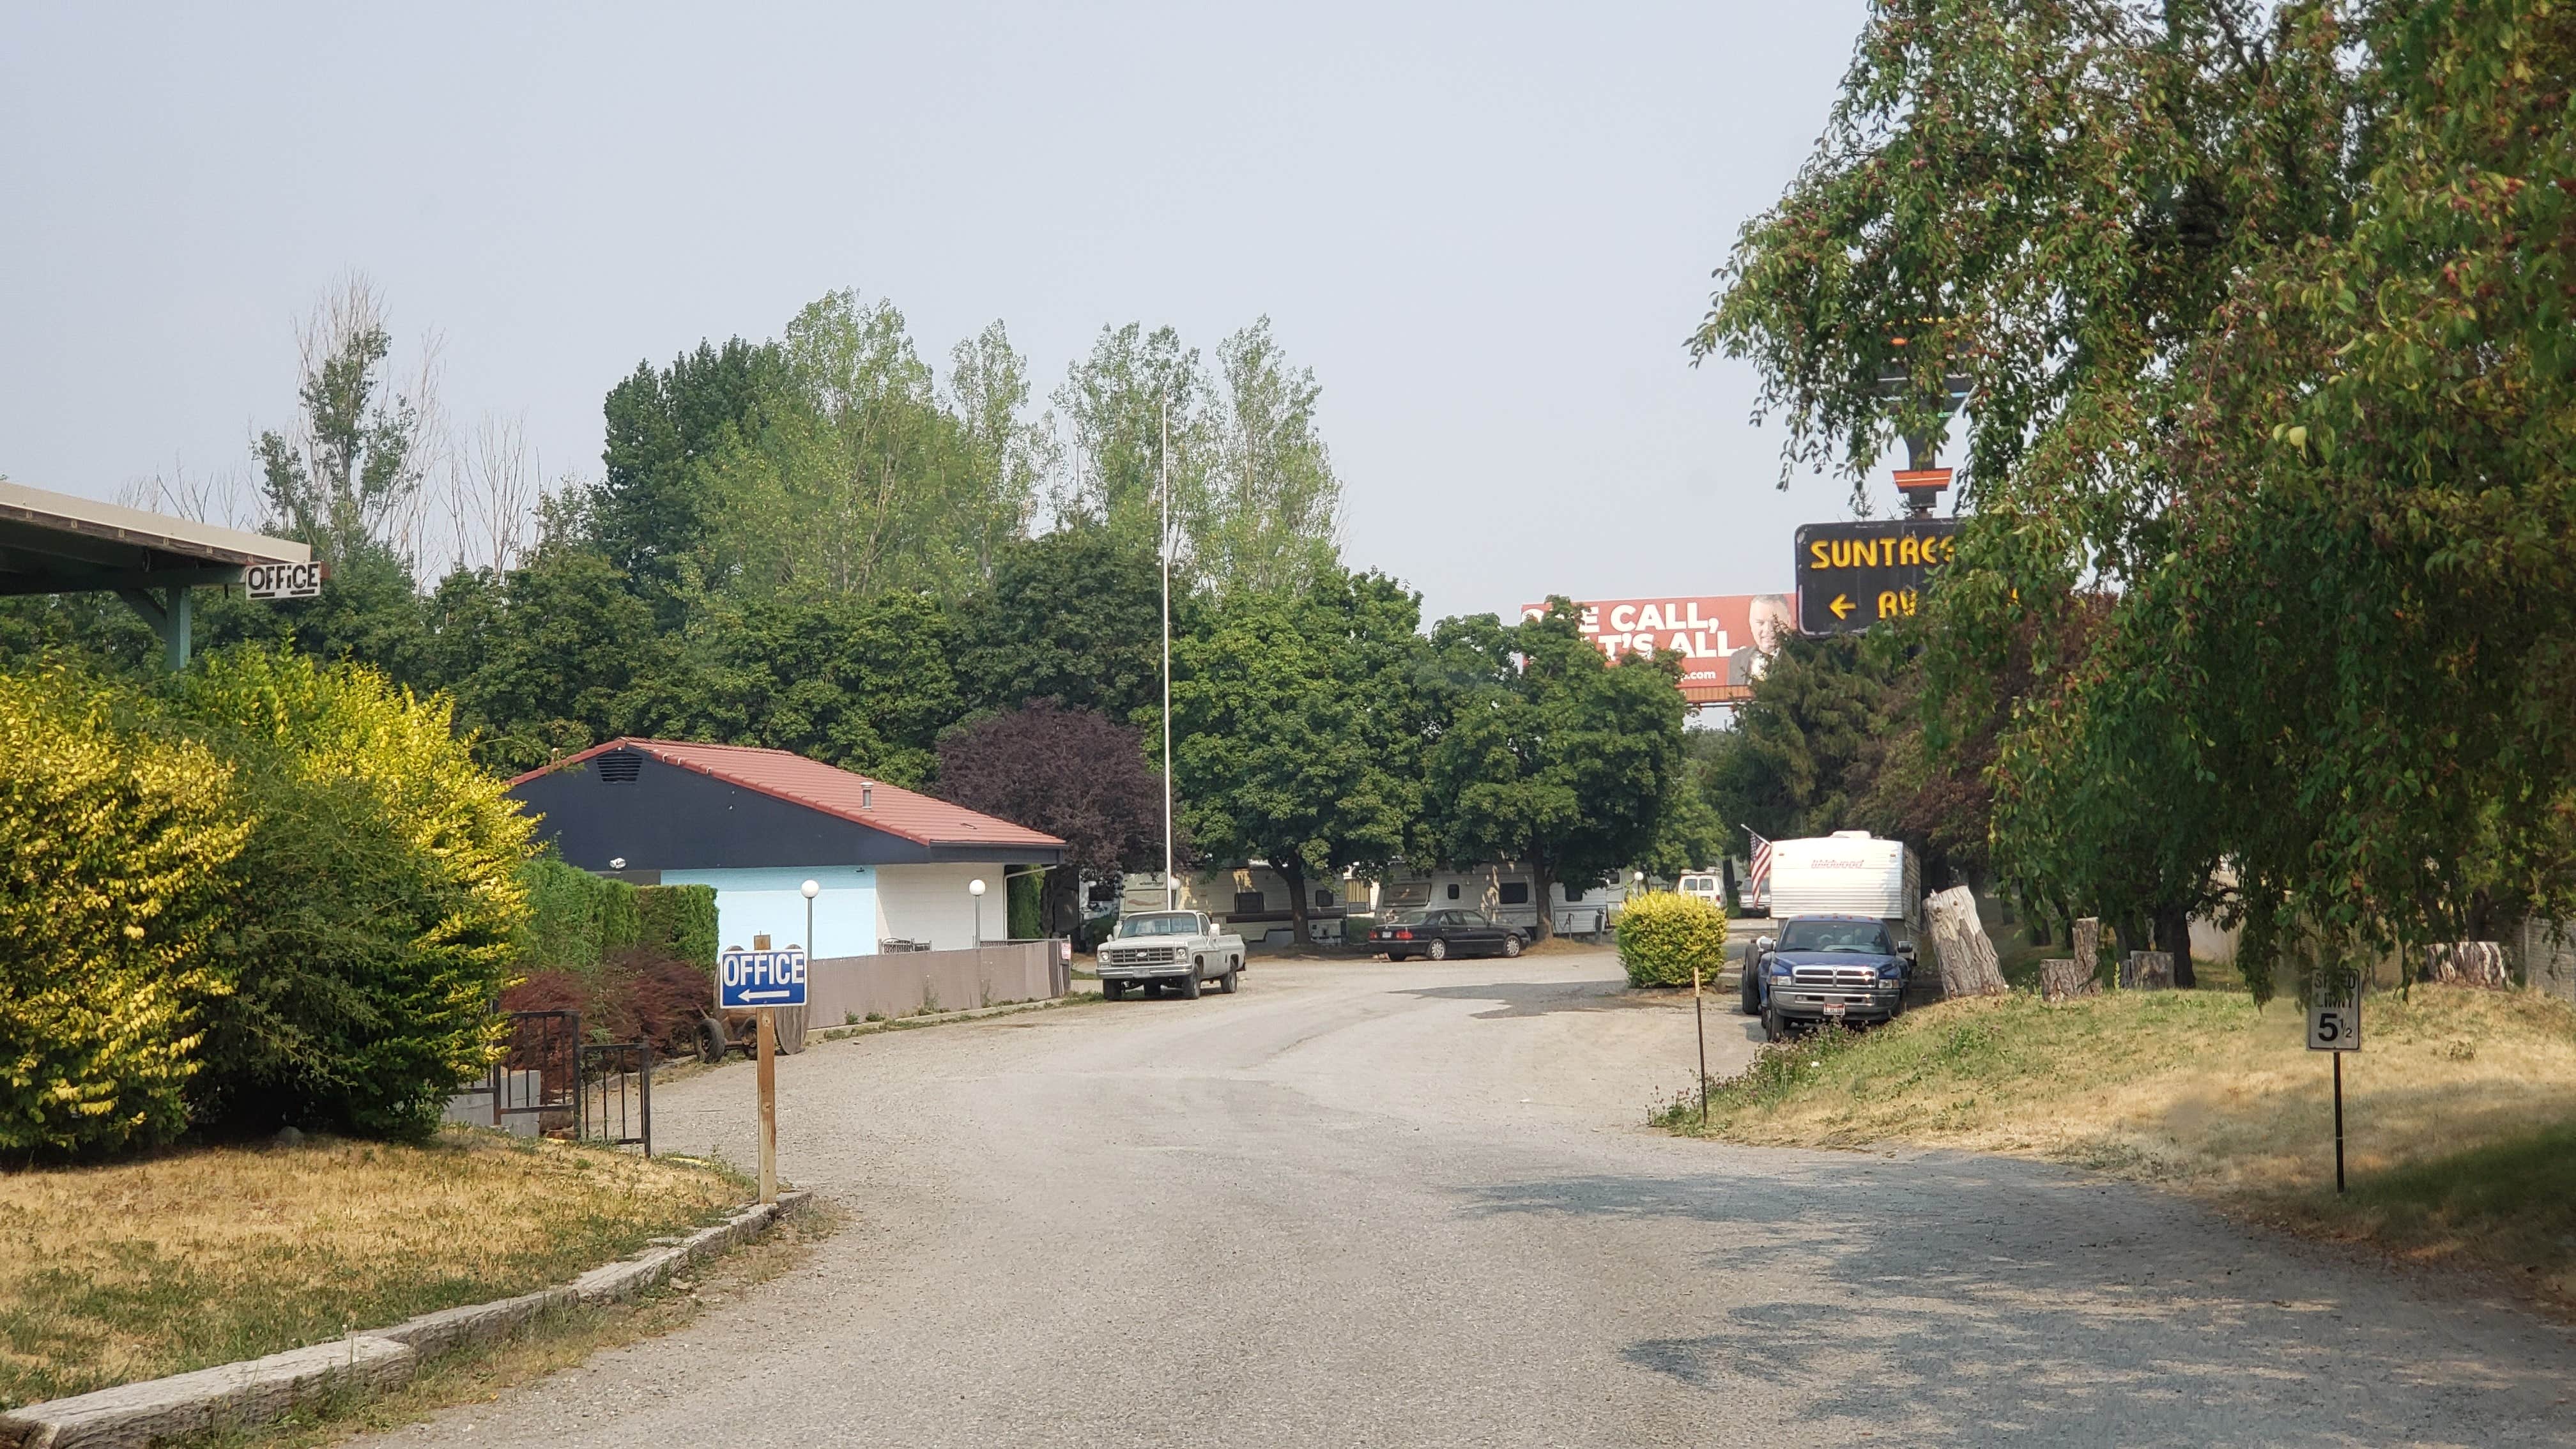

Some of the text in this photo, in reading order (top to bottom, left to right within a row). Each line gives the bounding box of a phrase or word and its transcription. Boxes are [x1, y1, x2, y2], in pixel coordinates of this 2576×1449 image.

[1611, 602, 1720, 634] CALL,
[1669, 630, 1748, 659] ALL
[723, 954, 804, 986] OFFICE
[2315, 972, 2356, 989] SED
[2315, 990, 2352, 1008] IMI
